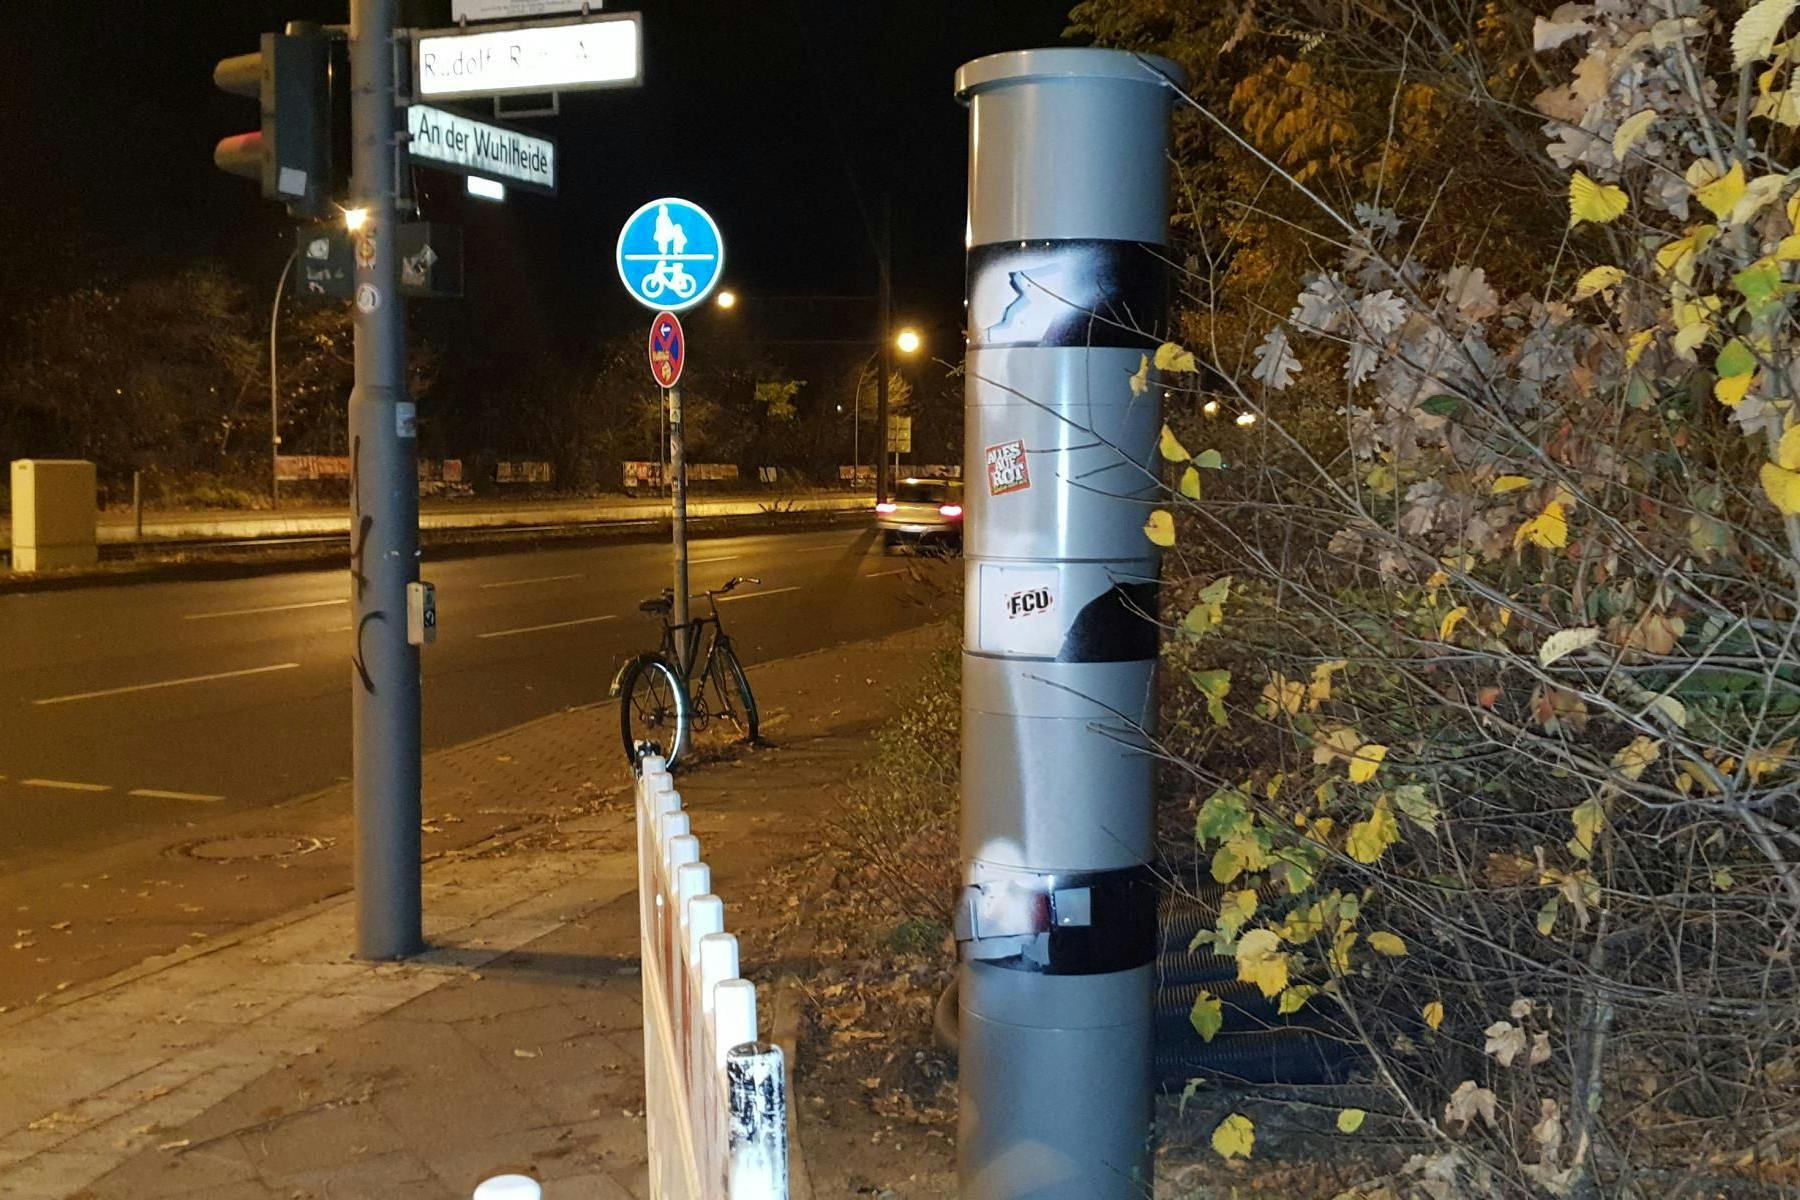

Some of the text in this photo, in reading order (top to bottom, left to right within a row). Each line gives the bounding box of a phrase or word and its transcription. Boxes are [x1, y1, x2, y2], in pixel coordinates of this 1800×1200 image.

[418, 112, 549, 175] An der Wuhlheide
[1010, 590, 1049, 615] FCU
